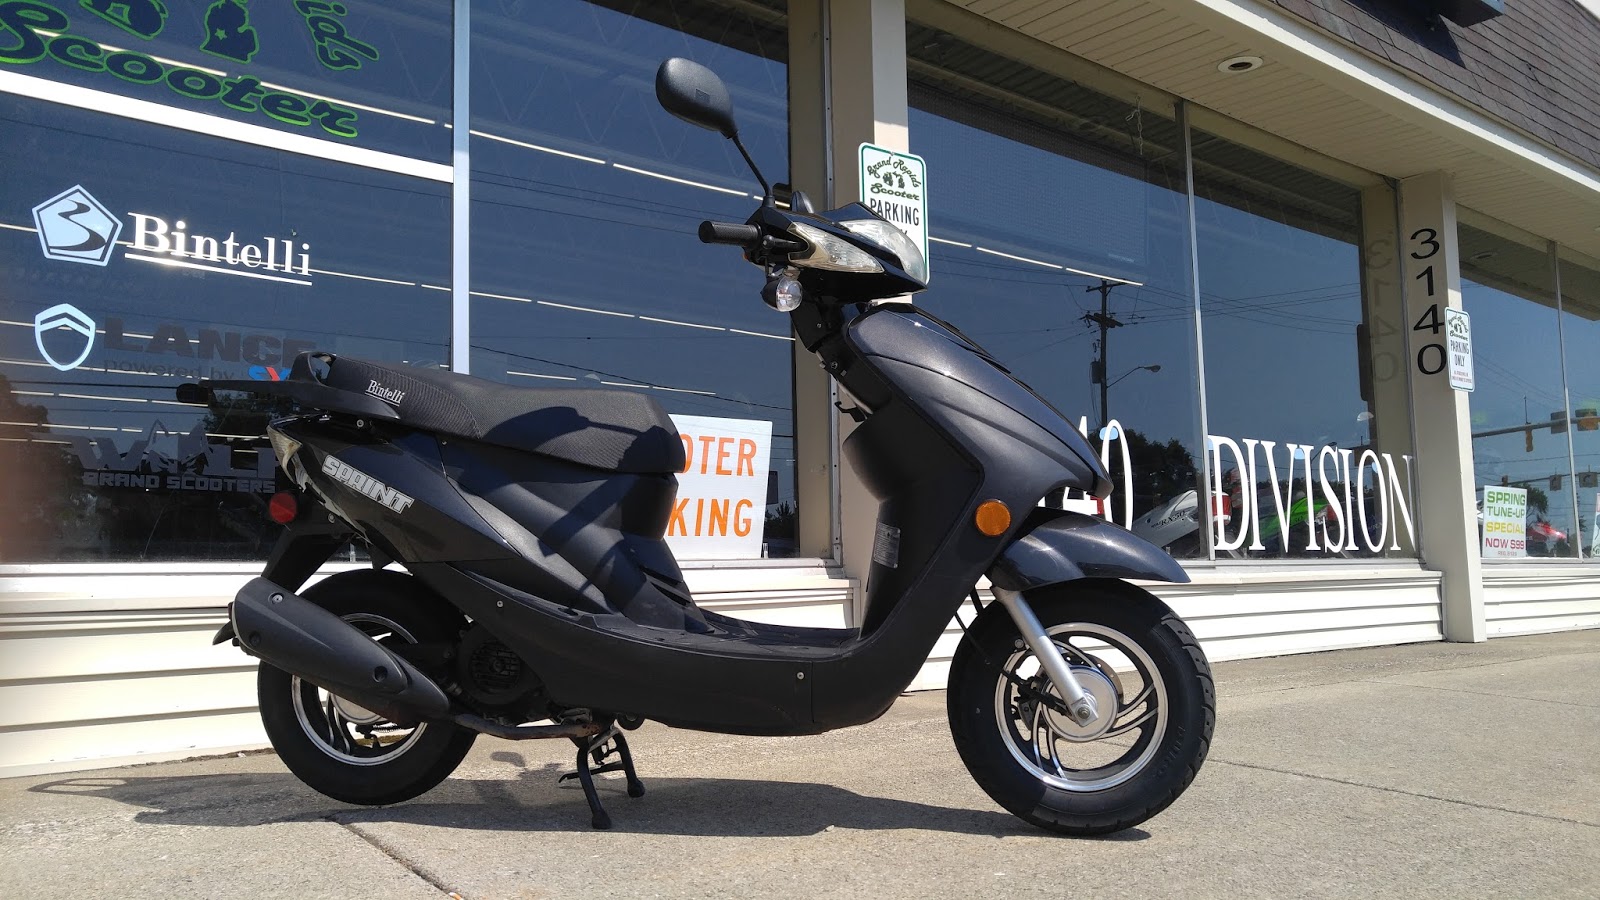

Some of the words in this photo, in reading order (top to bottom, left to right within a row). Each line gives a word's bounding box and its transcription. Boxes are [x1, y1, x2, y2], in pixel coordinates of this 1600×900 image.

[0, 1, 357, 138] Scooter
[866, 156, 892, 179] Grand
[893, 158, 922, 188] Rapids
[870, 183, 920, 201] Scooter
[869, 197, 920, 227] PARKING
[127, 211, 313, 277] Bintelli
[1409, 228, 1448, 375] 3140
[1450, 339, 1470, 355] PARKING
[103, 358, 201, 379] powered
[1454, 353, 1466, 368] ONLY
[366, 379, 405, 404] Bintelli
[82, 471, 160, 489] BRAND
[166, 475, 276, 494] SCOOTERS
[321, 454, 415, 515] SPRINT
[1208, 434, 1415, 553] DIVISION
[1486, 491, 1526, 506] SPRING
[667, 497, 753, 537] KING
[1486, 505, 1526, 519] TUNE-UP
[1485, 521, 1525, 535] SPECIAL
[1485, 537, 1509, 549] NOW
